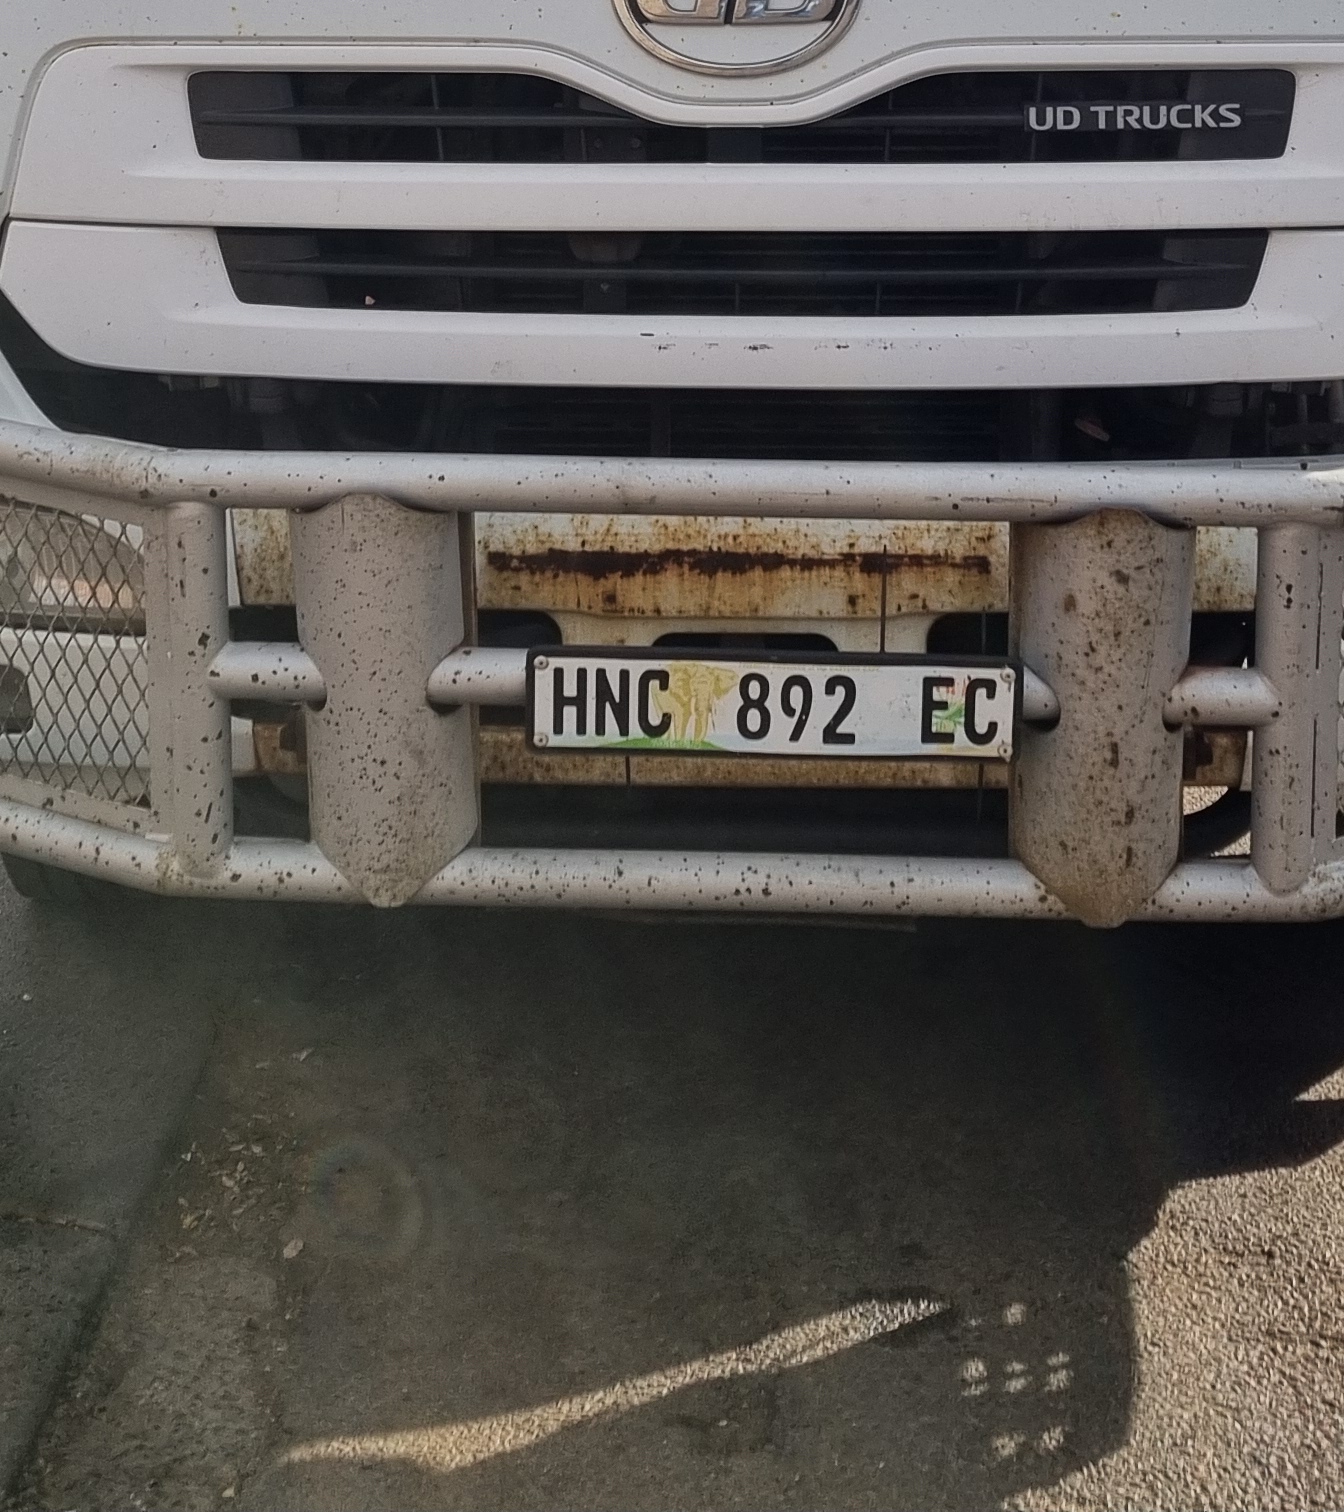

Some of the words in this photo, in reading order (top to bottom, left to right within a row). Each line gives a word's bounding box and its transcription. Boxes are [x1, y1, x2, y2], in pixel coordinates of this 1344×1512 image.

[1028, 105, 1081, 131] UD
[1089, 103, 1242, 130] TRUCKS
[552, 666, 673, 739] HNC
[736, 672, 857, 745] 892
[920, 675, 999, 746] EC
